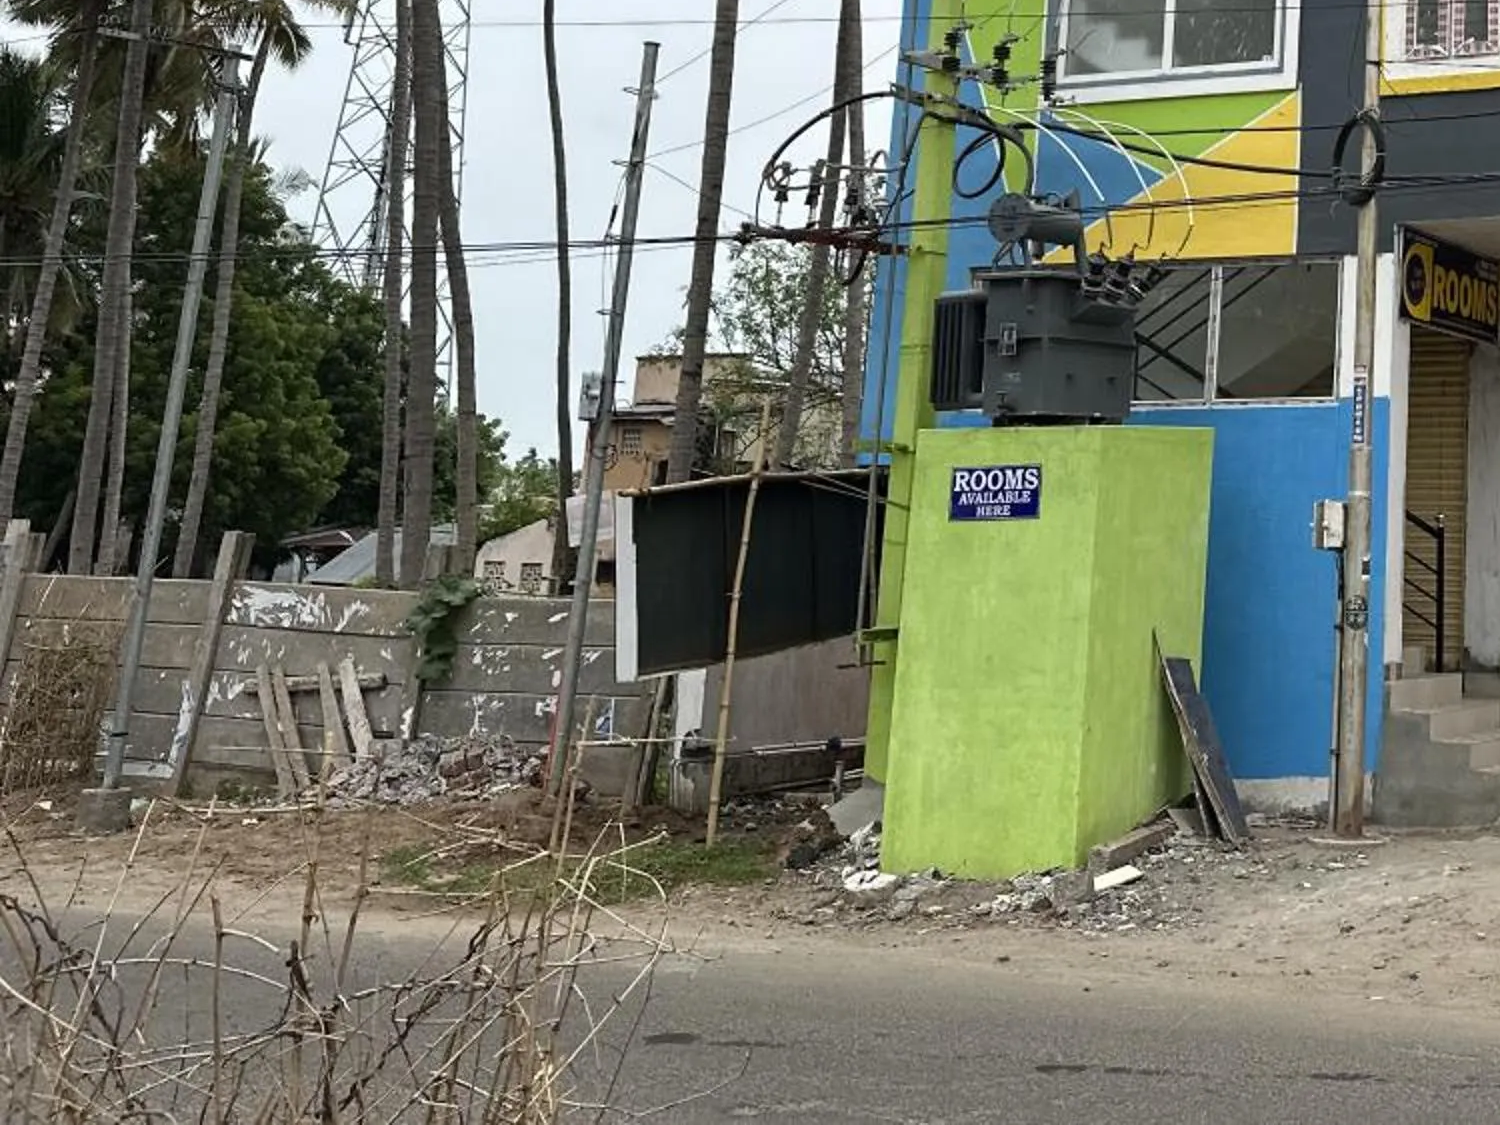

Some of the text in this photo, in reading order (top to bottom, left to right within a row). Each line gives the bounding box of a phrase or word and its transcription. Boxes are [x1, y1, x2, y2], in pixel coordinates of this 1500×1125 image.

[1433, 264, 1498, 327] ROOMS
[953, 468, 1039, 492] ROOMS
[958, 490, 1031, 506] AVAILABLE
[975, 504, 1011, 517] HERE
